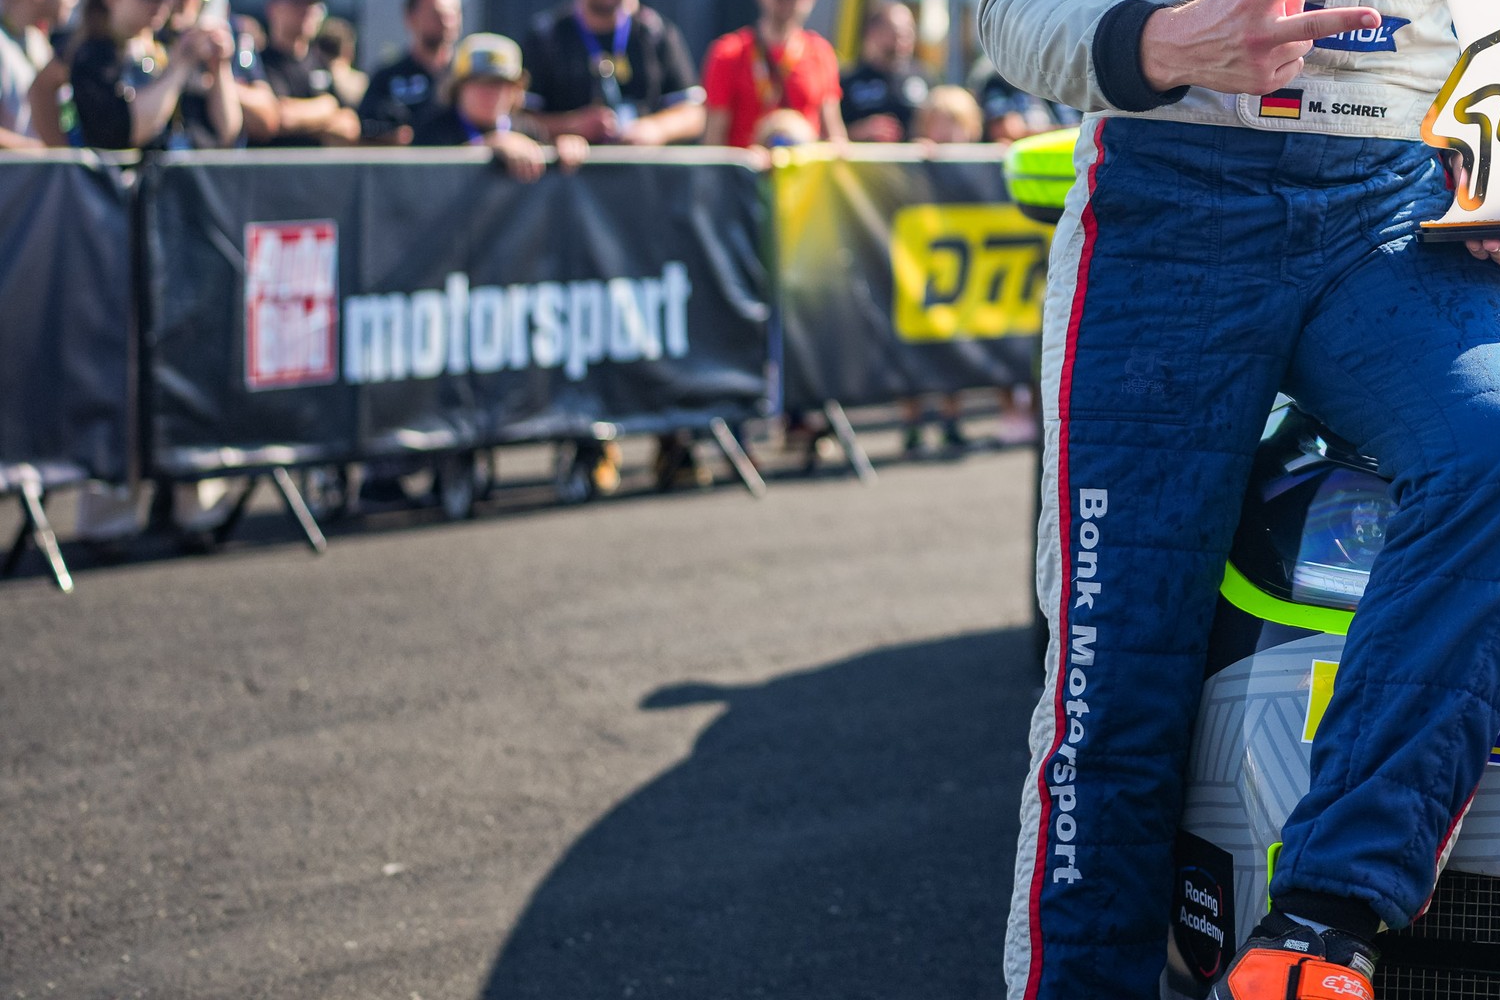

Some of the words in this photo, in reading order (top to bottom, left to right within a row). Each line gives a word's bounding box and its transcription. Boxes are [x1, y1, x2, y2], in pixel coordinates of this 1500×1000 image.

[1308, 101, 1326, 113] M.
[1331, 102, 1388, 118] SCHREY
[344, 260, 691, 383] motorsport
[1073, 488, 1108, 609] Bonk
[1051, 625, 1097, 884] Motorsport
[1179, 906, 1224, 947] Academy
[1185, 880, 1218, 917] Racing
